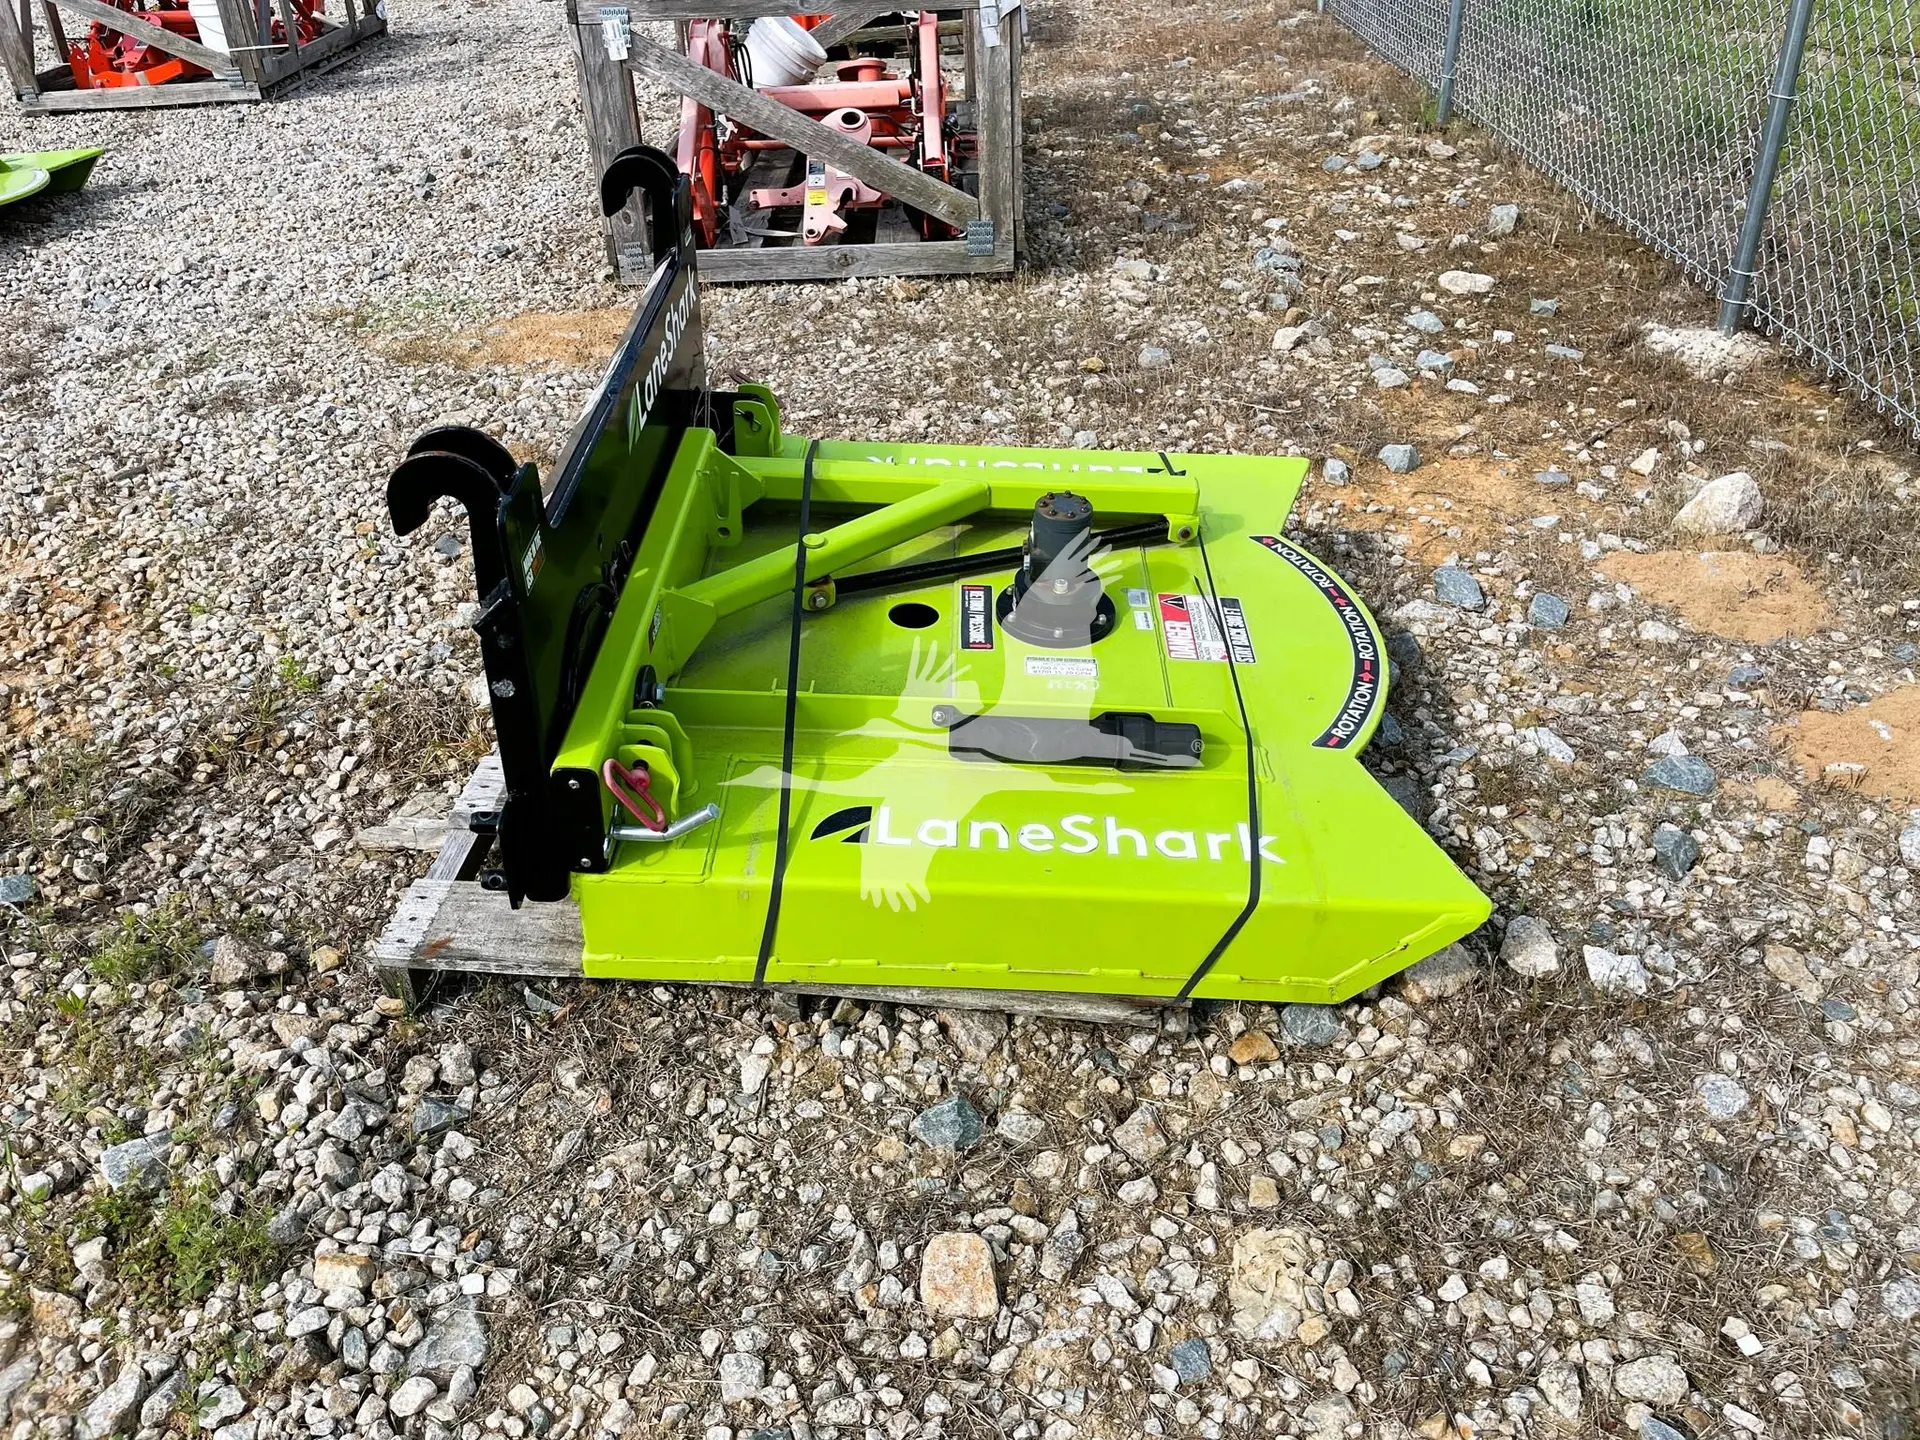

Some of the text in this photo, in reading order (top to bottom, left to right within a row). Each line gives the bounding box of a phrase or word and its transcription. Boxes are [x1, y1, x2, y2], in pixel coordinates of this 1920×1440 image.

[635, 264, 697, 431] LaneShark
[1270, 542, 1334, 588] ROTATION
[969, 614, 985, 643] PRESSURE
[1223, 607, 1241, 616] FT
[1164, 620, 1198, 659] DANGER
[1228, 628, 1250, 646] BACK
[1232, 646, 1255, 662] STAY
[1339, 606, 1375, 660] ROTATION
[1331, 681, 1374, 739] ROTATION
[877, 805, 1287, 865] LaneShark
